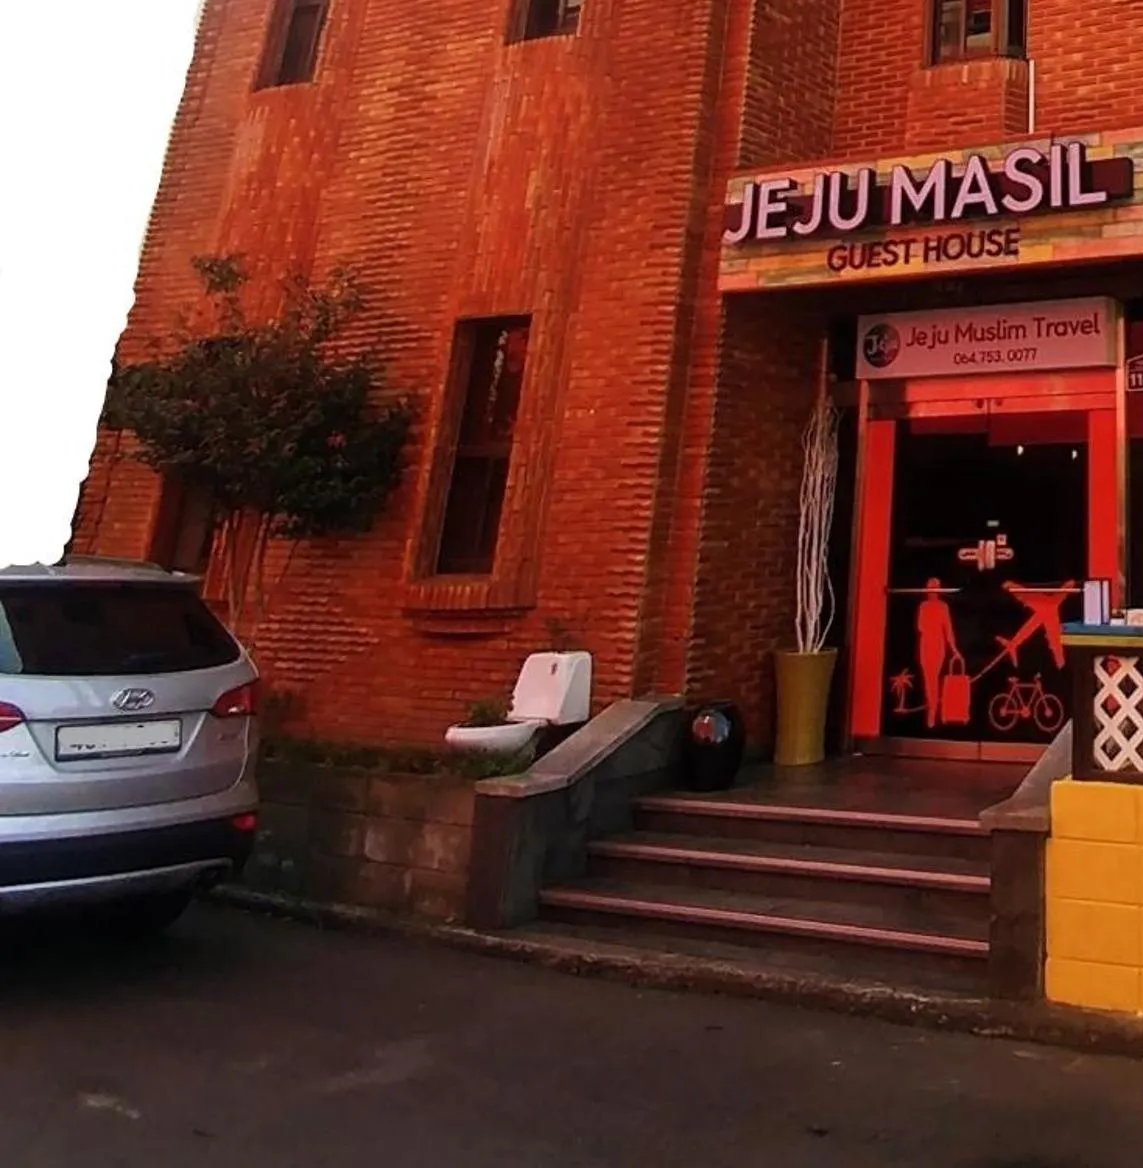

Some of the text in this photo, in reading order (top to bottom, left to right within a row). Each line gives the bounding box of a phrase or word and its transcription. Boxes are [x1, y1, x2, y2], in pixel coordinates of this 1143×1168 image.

[724, 141, 1107, 244] JEJU MASIL
[826, 228, 1021, 271] GUEST HOUSE
[906, 313, 1100, 349] Jeju Muslim Travel
